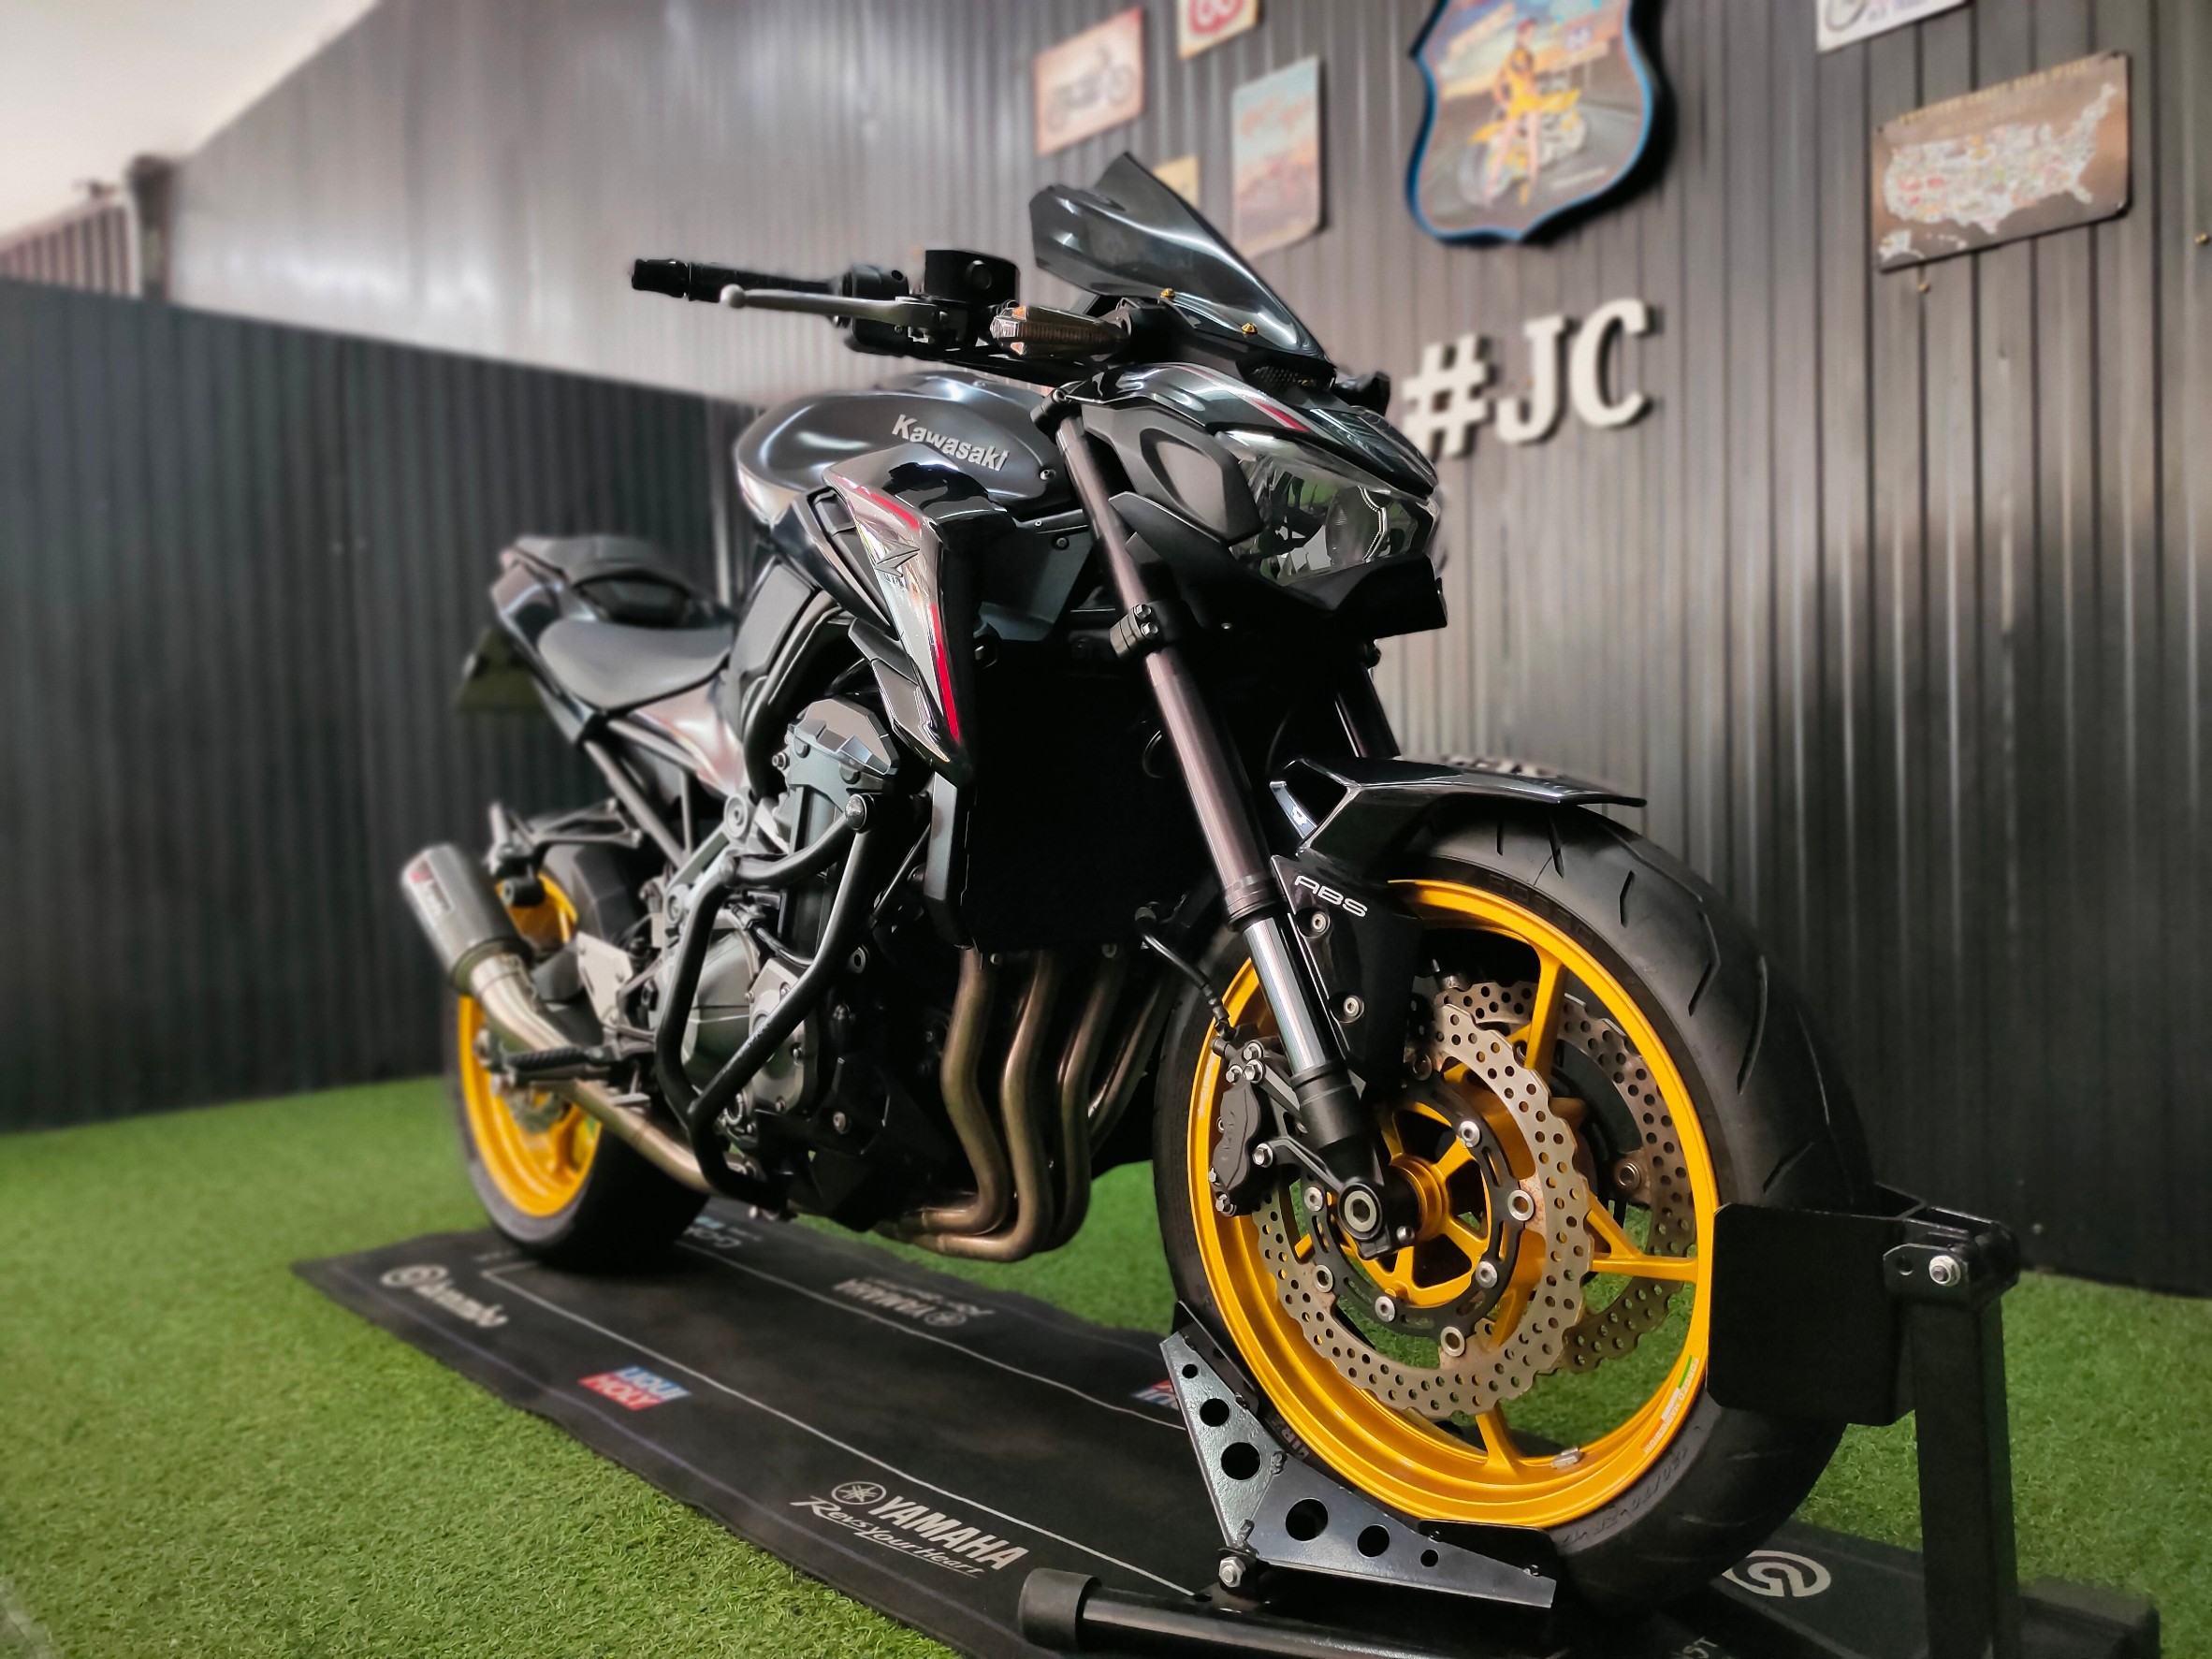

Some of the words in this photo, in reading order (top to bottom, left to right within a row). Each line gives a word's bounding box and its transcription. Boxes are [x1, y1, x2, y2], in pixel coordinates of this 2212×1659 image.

[1403, 297, 1649, 461] #JC
[892, 414, 1010, 472] Kawasaki
[1294, 875, 1369, 918] ABS
[790, 1495, 868, 1530] Revs
[853, 1525, 923, 1550] Your
[921, 1548, 985, 1574] Heart
[867, 1496, 1028, 1570] YAMAHA
